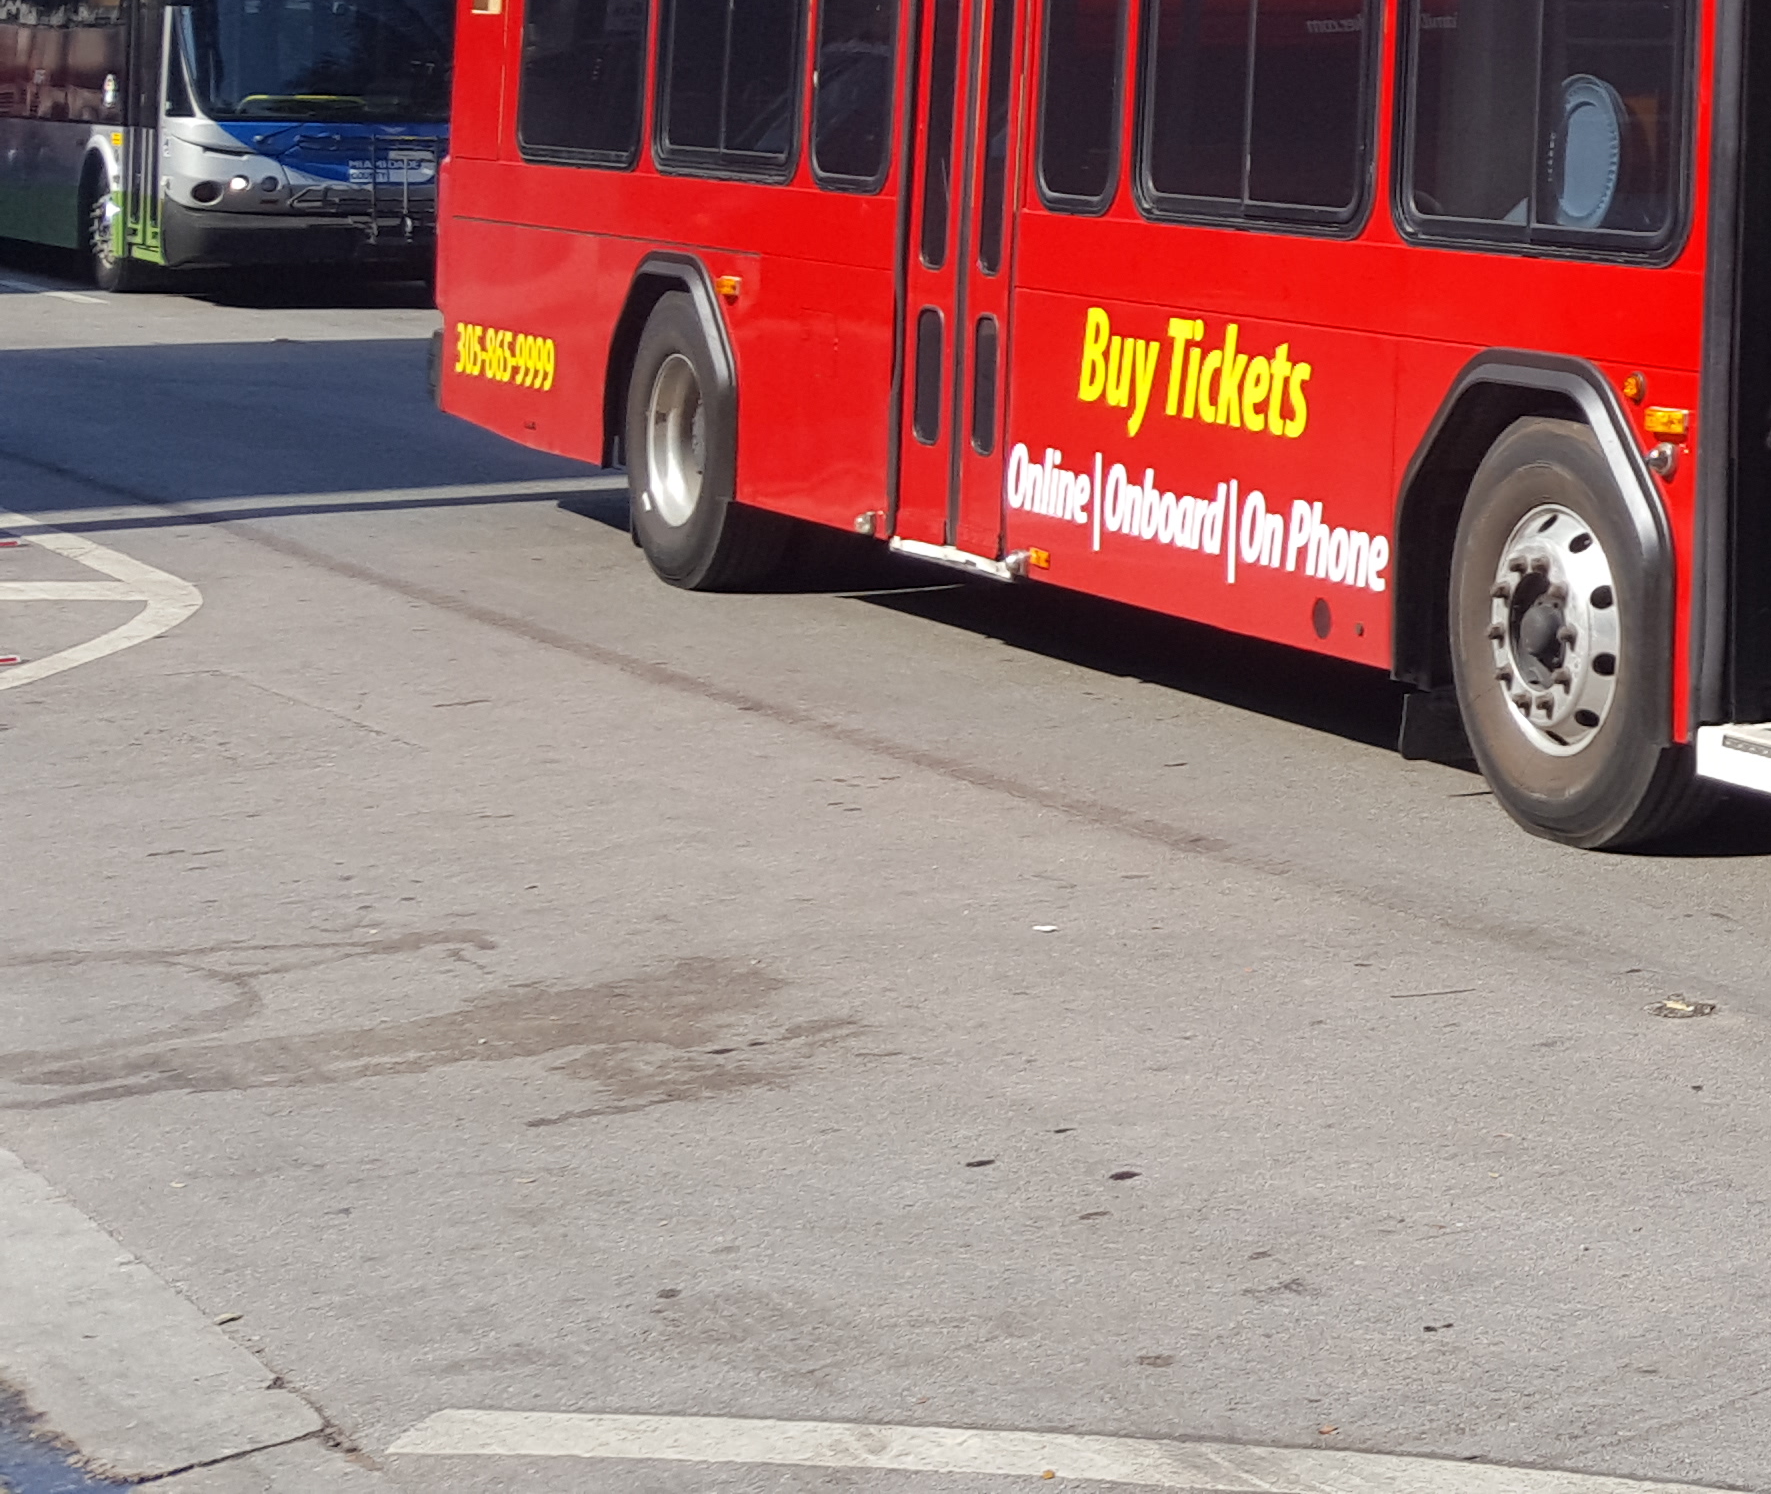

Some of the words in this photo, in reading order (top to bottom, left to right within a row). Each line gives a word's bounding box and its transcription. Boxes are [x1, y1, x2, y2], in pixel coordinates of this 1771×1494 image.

[455, 322, 555, 391] 305-865-9999
[1077, 307, 1160, 438] Buy
[1165, 317, 1312, 438] Tickets
[1240, 490, 1284, 569] On
[1285, 499, 1389, 592] Phone
